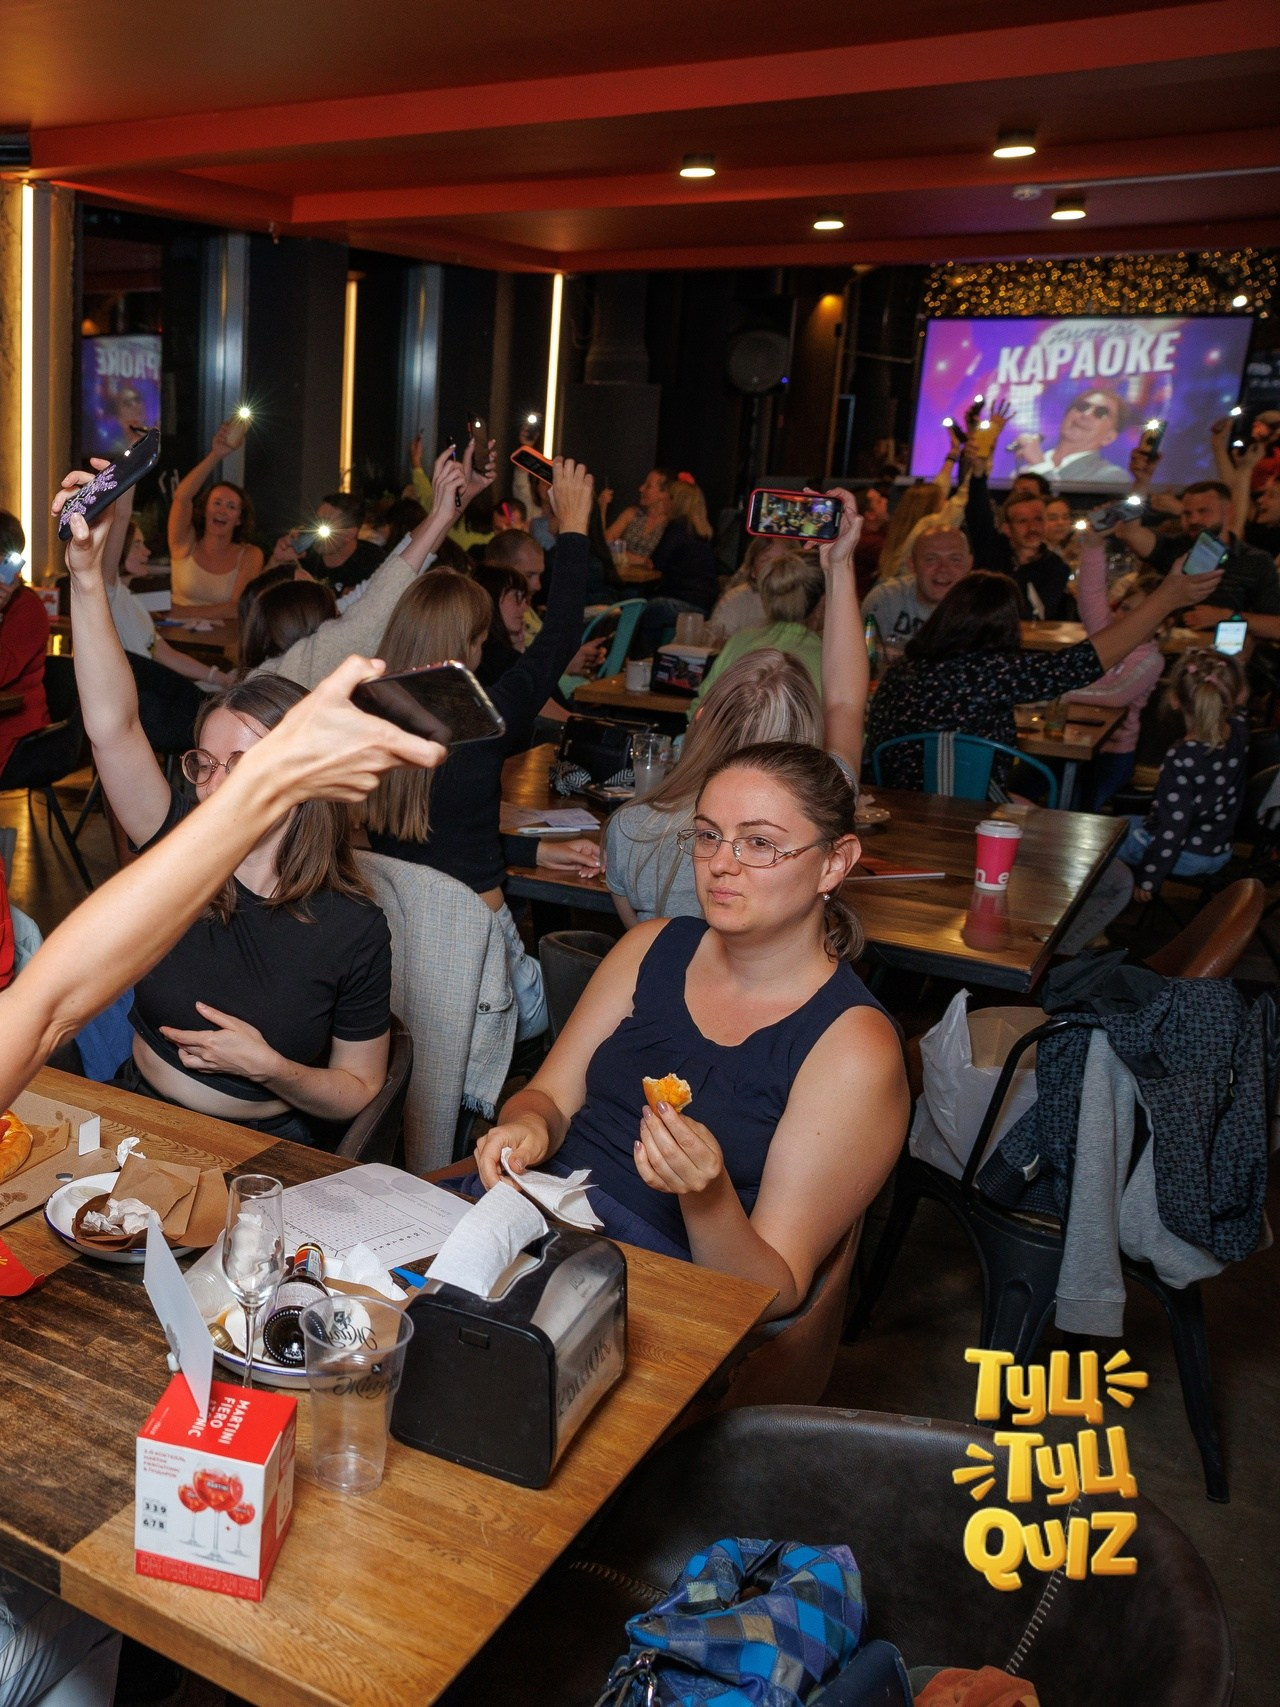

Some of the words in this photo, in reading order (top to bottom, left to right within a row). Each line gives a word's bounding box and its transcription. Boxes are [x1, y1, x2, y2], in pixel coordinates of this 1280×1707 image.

[997, 330, 1182, 385] КАРАОКЕ
[210, 1396, 236, 1428] FIERO
[218, 1398, 251, 1445] MARTINI
